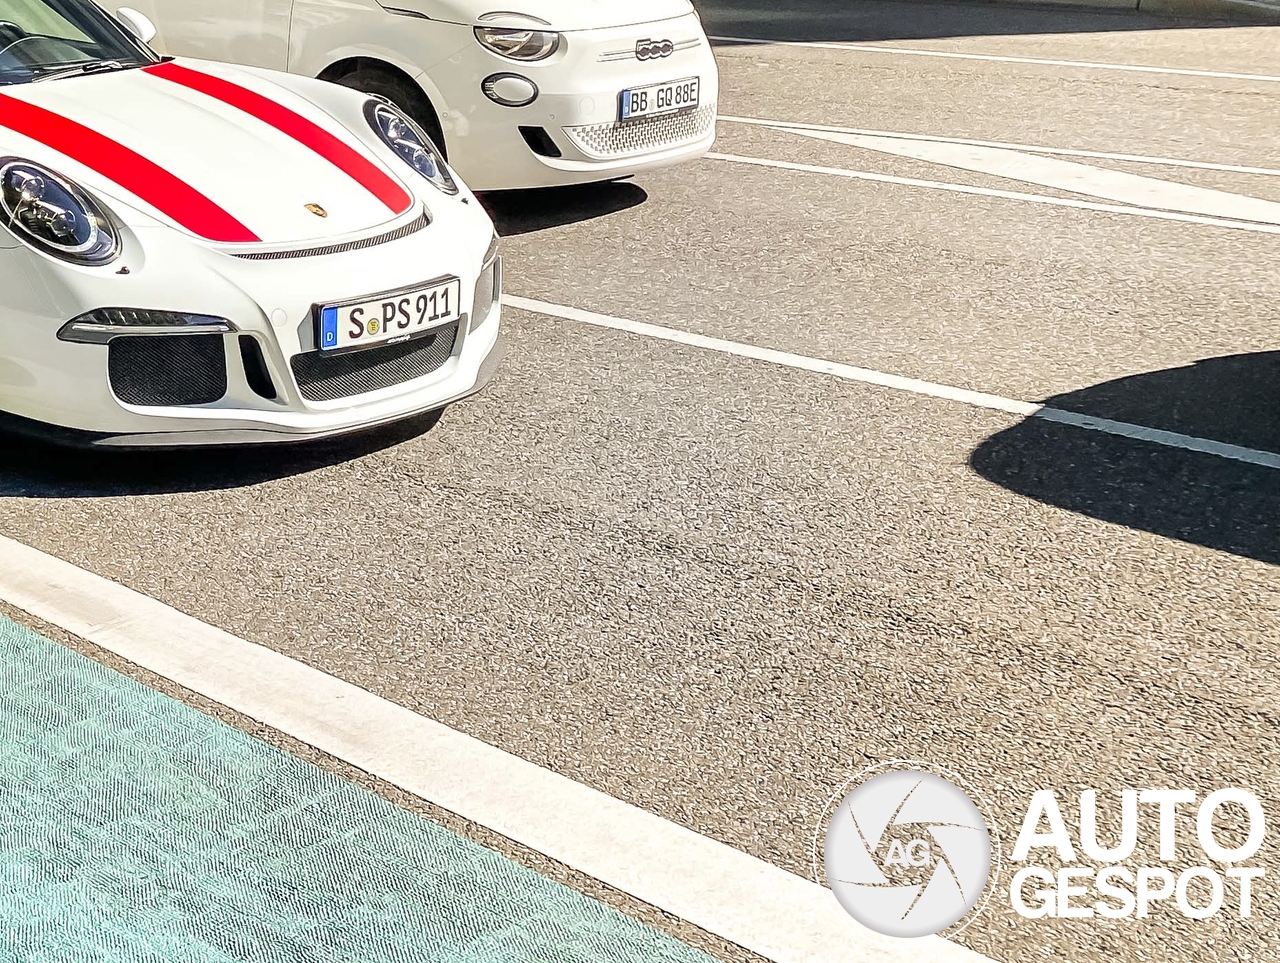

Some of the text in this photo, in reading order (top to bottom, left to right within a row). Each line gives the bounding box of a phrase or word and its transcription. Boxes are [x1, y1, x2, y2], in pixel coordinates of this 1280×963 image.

[636, 39, 674, 61] 500
[631, 91, 648, 113] BB
[657, 87, 673, 108] GQ
[675, 82, 697, 104] 88E
[326, 287, 452, 342] D S PS 911
